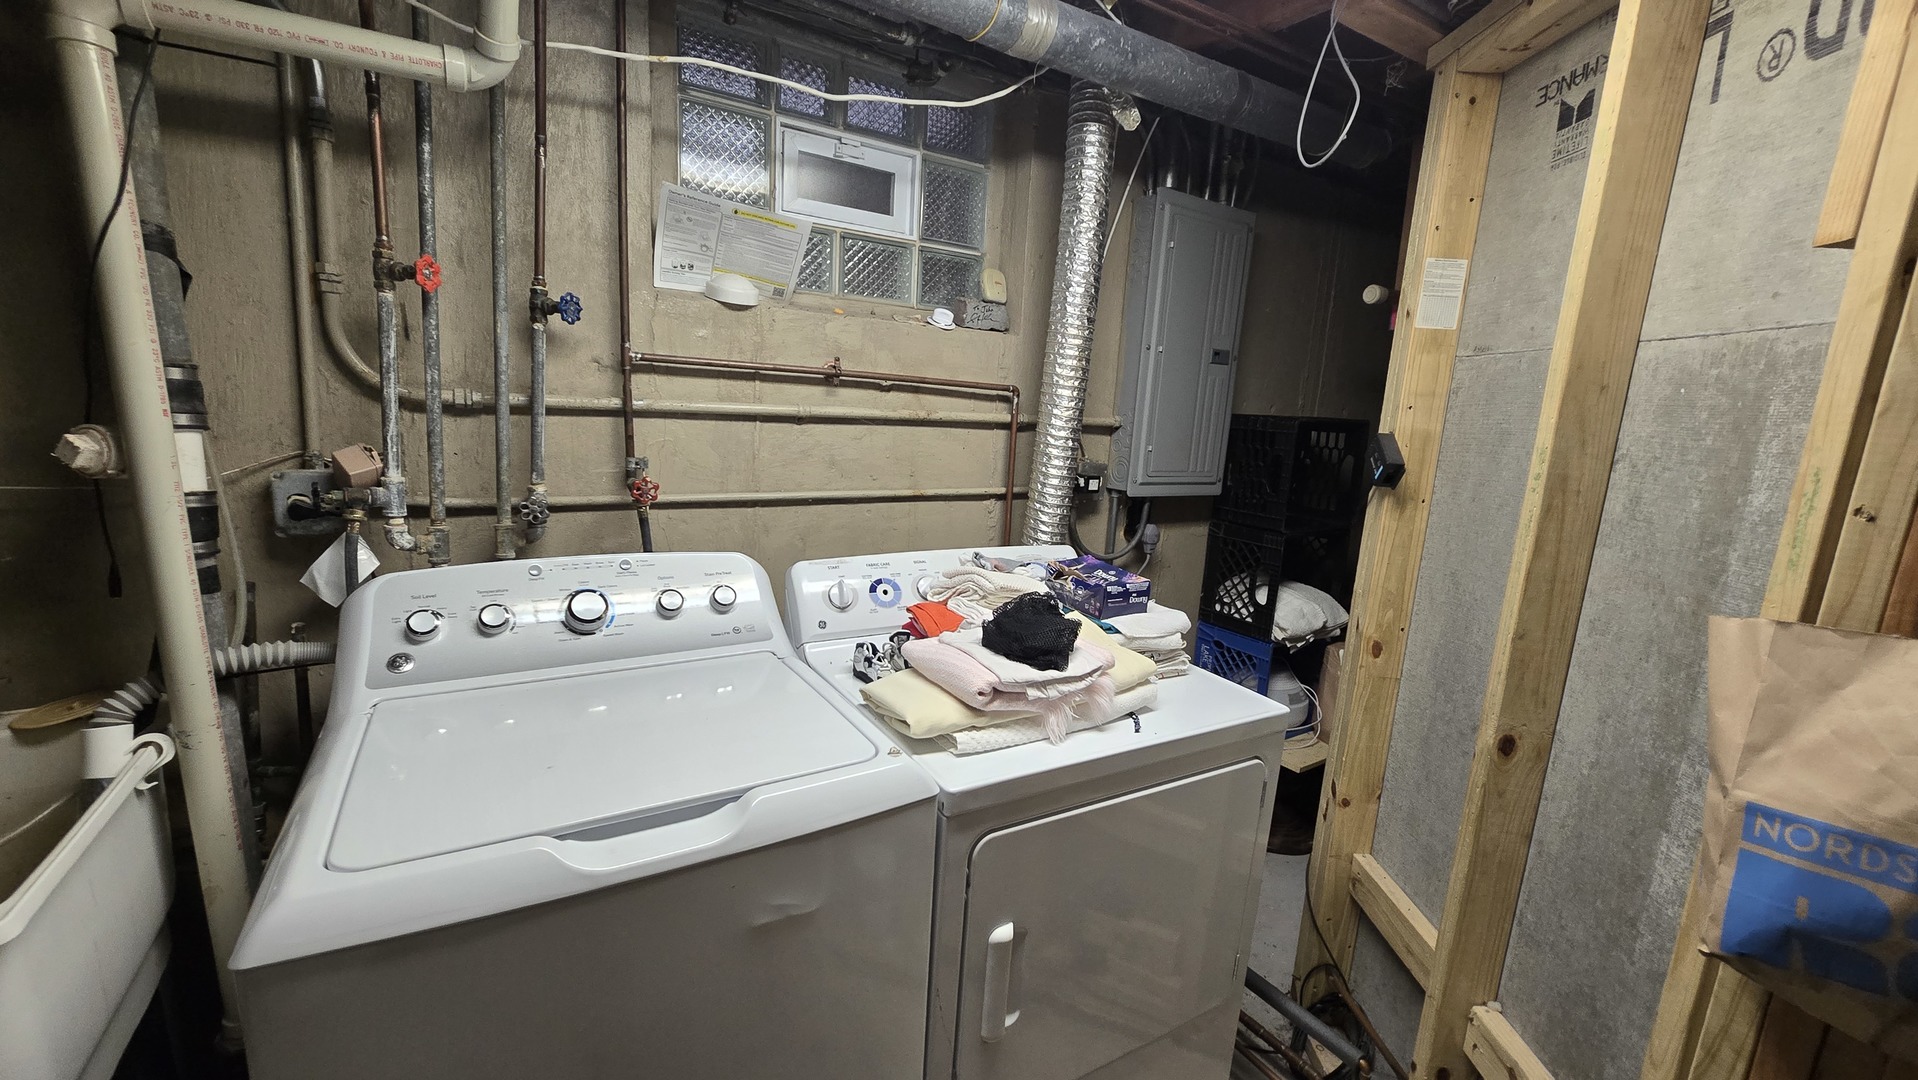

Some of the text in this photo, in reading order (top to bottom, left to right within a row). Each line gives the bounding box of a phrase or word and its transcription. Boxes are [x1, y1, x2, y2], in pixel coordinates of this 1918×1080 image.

[347, 43, 379, 56] FOUNDRY
[388, 51, 405, 62] PIPE
[407, 55, 443, 69] CHARLOTTE
[1551, 135, 1589, 160] LIFETIME
[1129, 596, 1148, 604] Downy
